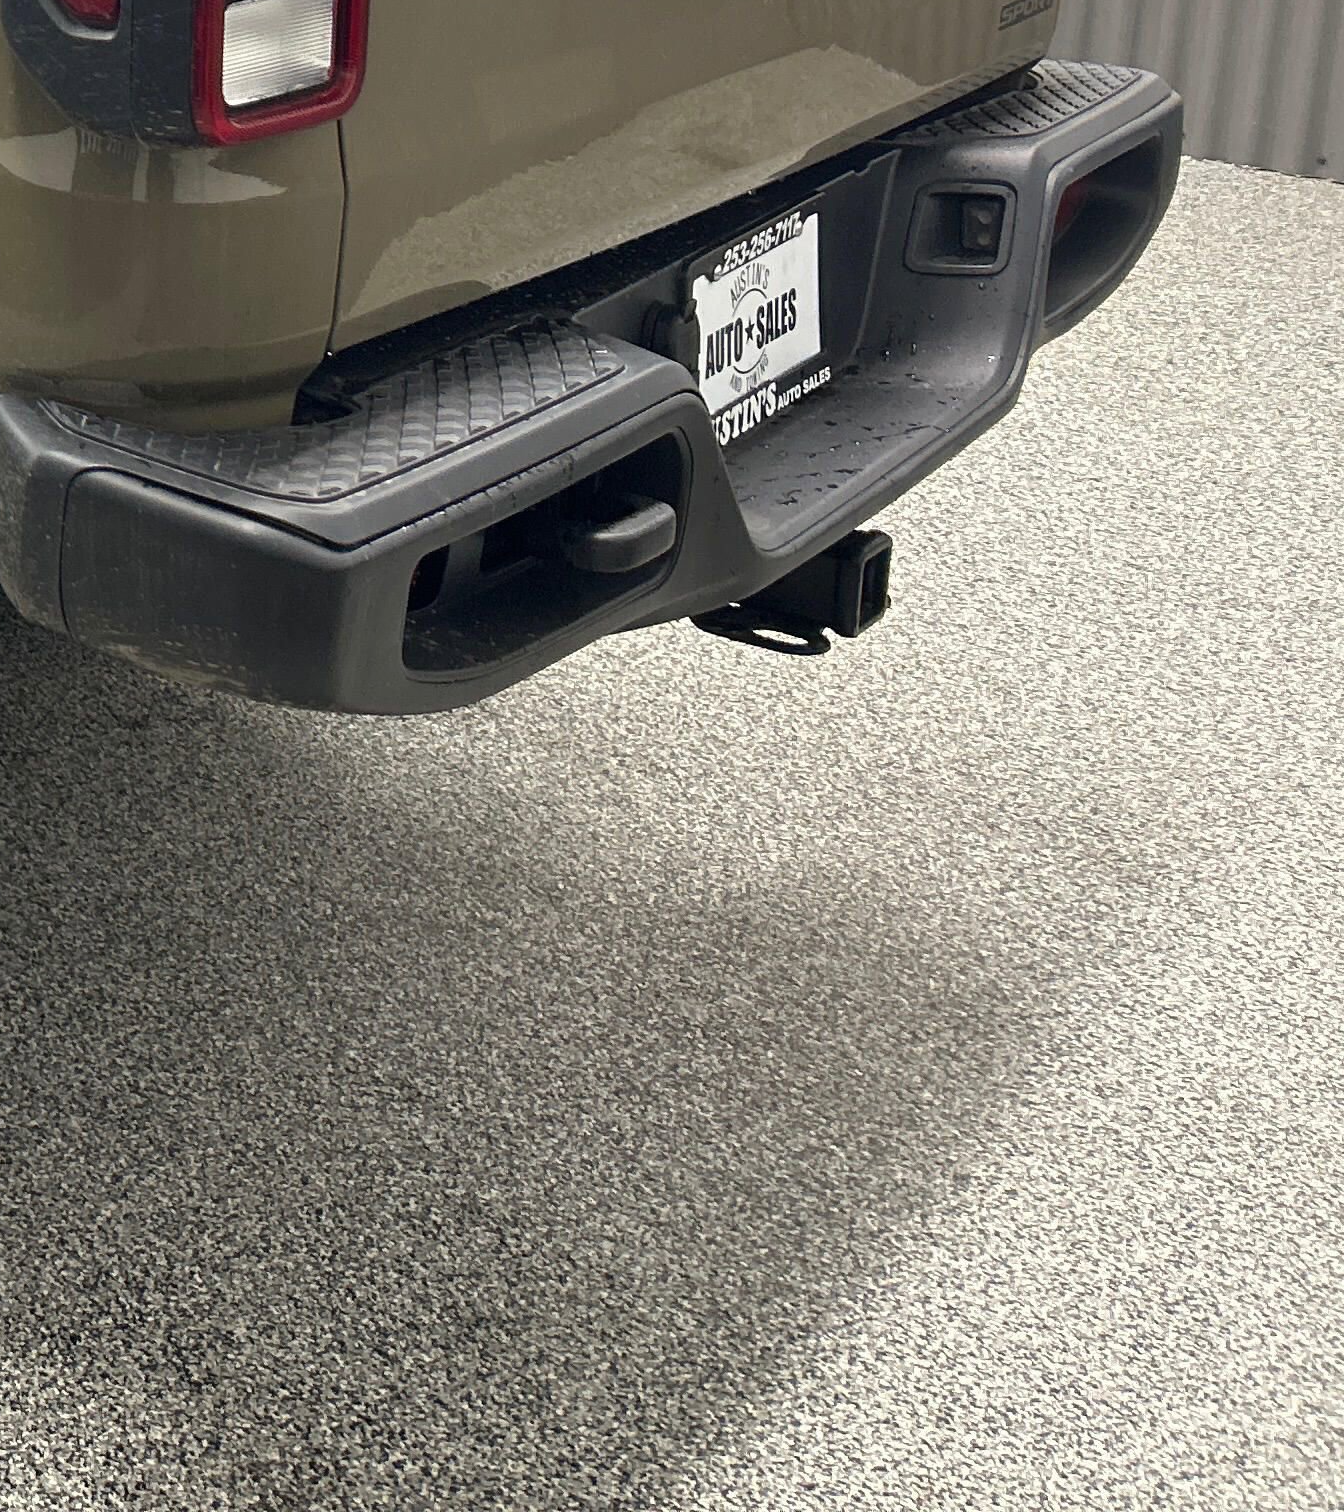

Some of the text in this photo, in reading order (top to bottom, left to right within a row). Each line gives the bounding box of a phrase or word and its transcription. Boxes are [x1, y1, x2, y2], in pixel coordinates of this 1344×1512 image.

[730, 262, 770, 308] AUSTIN'S
[705, 288, 797, 380] AUTO SALES
[778, 384, 802, 411] AUTO
[802, 366, 831, 394] SALES
